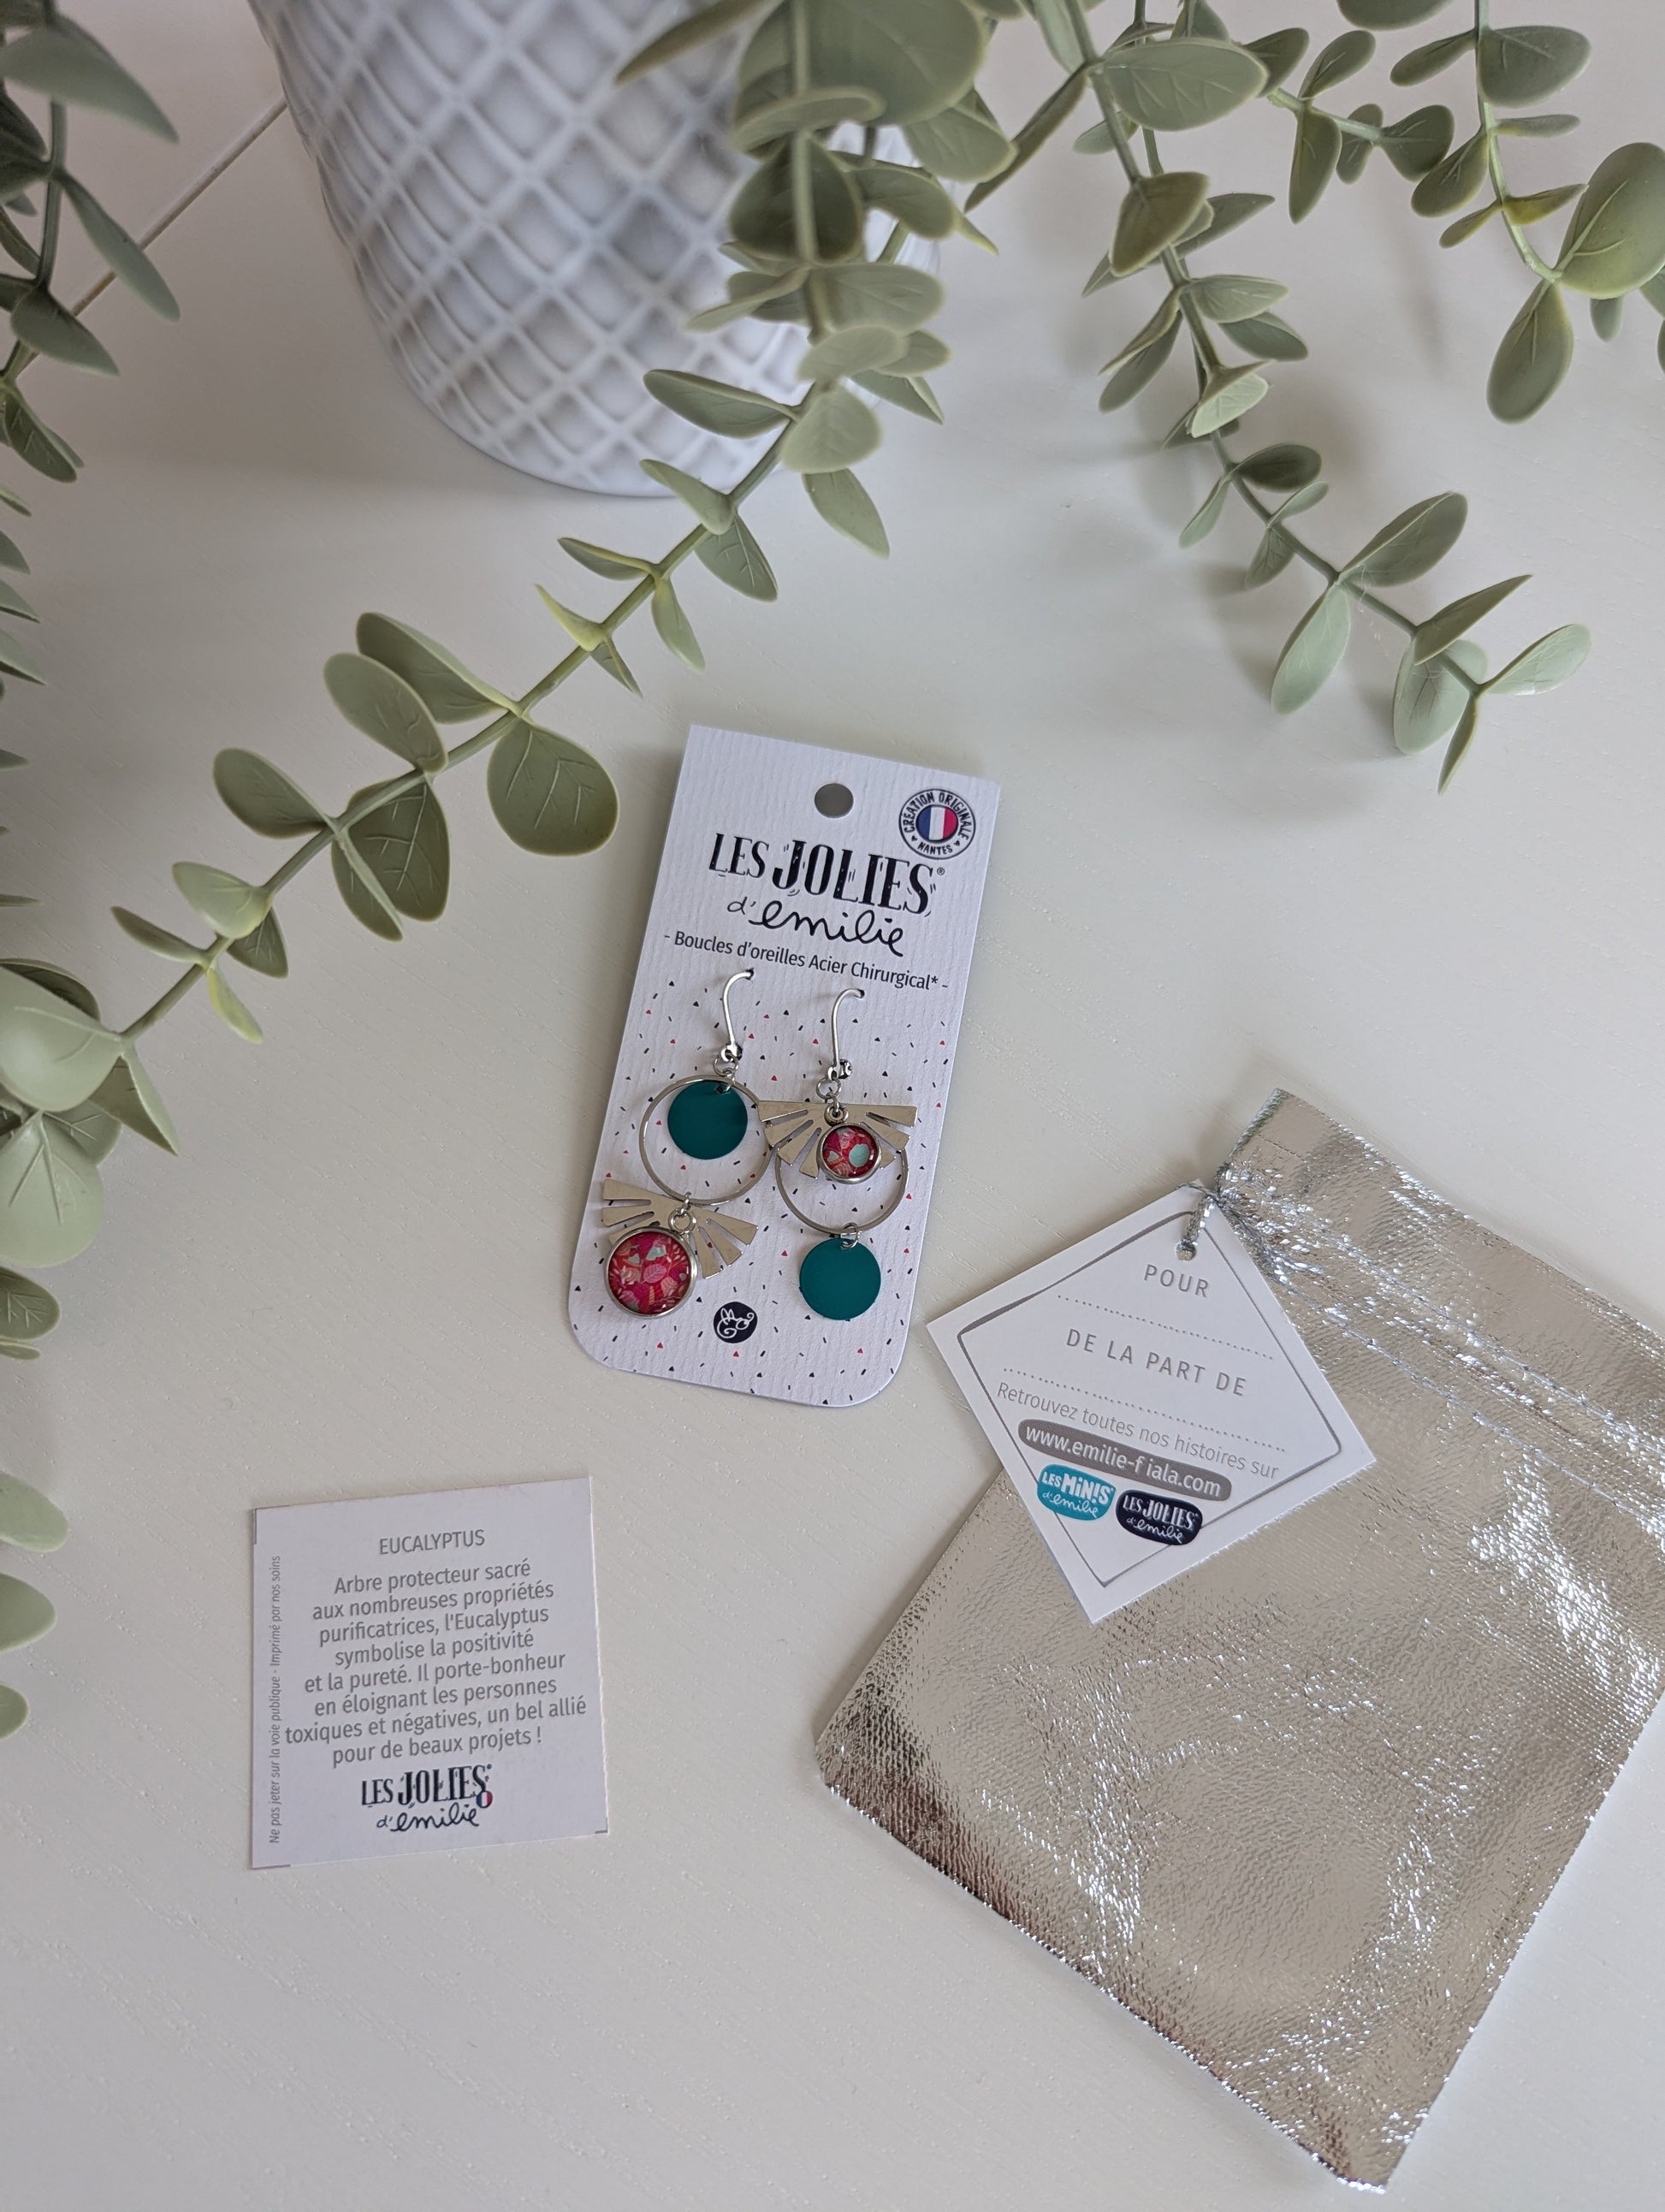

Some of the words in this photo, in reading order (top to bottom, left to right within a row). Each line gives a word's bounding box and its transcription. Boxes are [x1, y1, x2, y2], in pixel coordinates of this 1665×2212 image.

[939, 792, 972, 840] ORIGINALE
[709, 833, 769, 878] LES
[918, 841, 953, 855] NANTES
[675, 931, 732, 954] Boucles
[738, 941, 805, 967] d'oreilles
[809, 955, 848, 974] Acier
[1144, 1265, 1208, 1297] POUR
[1067, 1329, 1096, 1352] DE
[1107, 1341, 1132, 1364] LA
[1146, 1352, 1205, 1383] PART
[1216, 1373, 1246, 1396] DE
[998, 1382, 1078, 1420] Retrouvez
[1083, 1408, 1134, 1436] toutes
[1140, 1428, 1169, 1447] nos
[1174, 1434, 1247, 1468] histoires
[1251, 1462, 1278, 1479] sur
[1041, 1472, 1062, 1487] LES
[1123, 1495, 1143, 1512] LES
[380, 1529, 485, 1554] EUCALYPTUS
[270, 1556, 281, 1581] soins
[335, 1575, 382, 1594] Arbre
[388, 1568, 479, 1593] protecteur
[485, 1557, 530, 1580] sacré
[272, 1604, 282, 1622] par
[313, 1604, 344, 1620] aux
[350, 1593, 458, 1616] nombreuses
[464, 1580, 554, 1610] propriétés
[270, 1625, 282, 1665] Imprimé
[320, 1617, 439, 1647] purificatrices,
[446, 1608, 548, 1636] l'Eucalyptus
[335, 1640, 424, 1669] symbolise
[431, 1639, 446, 1656] la
[453, 1628, 533, 1658] positivité
[305, 1675, 323, 1693] et
[329, 1673, 343, 1690] la
[350, 1664, 412, 1695] pureté.
[418, 1663, 429, 1681] Il
[436, 1653, 566, 1684] porte-bonheur
[270, 1676, 282, 1722] publique
[315, 1701, 335, 1716] en
[342, 1690, 428, 1717] éloignant
[433, 1687, 458, 1705] les
[465, 1680, 556, 1705] personnes
[270, 1724, 280, 1746] voie
[285, 1722, 362, 1744] toxiques
[369, 1718, 386, 1735] et
[393, 1705, 481, 1735] négatives,
[488, 1708, 509, 1723] un
[516, 1700, 543, 1721] bel
[549, 1695, 586, 1717] allié
[270, 1747, 280, 1758] la
[334, 1746, 375, 1769] pour
[381, 1740, 403, 1758] de
[410, 1734, 463, 1756] beaux
[470, 1728, 531, 1754] projets
[271, 1760, 280, 1778] sur
[269, 1780, 281, 1805] jeter
[361, 1778, 394, 1806] LES
[271, 1806, 281, 1826] pas
[270, 1829, 280, 1843] Ne
